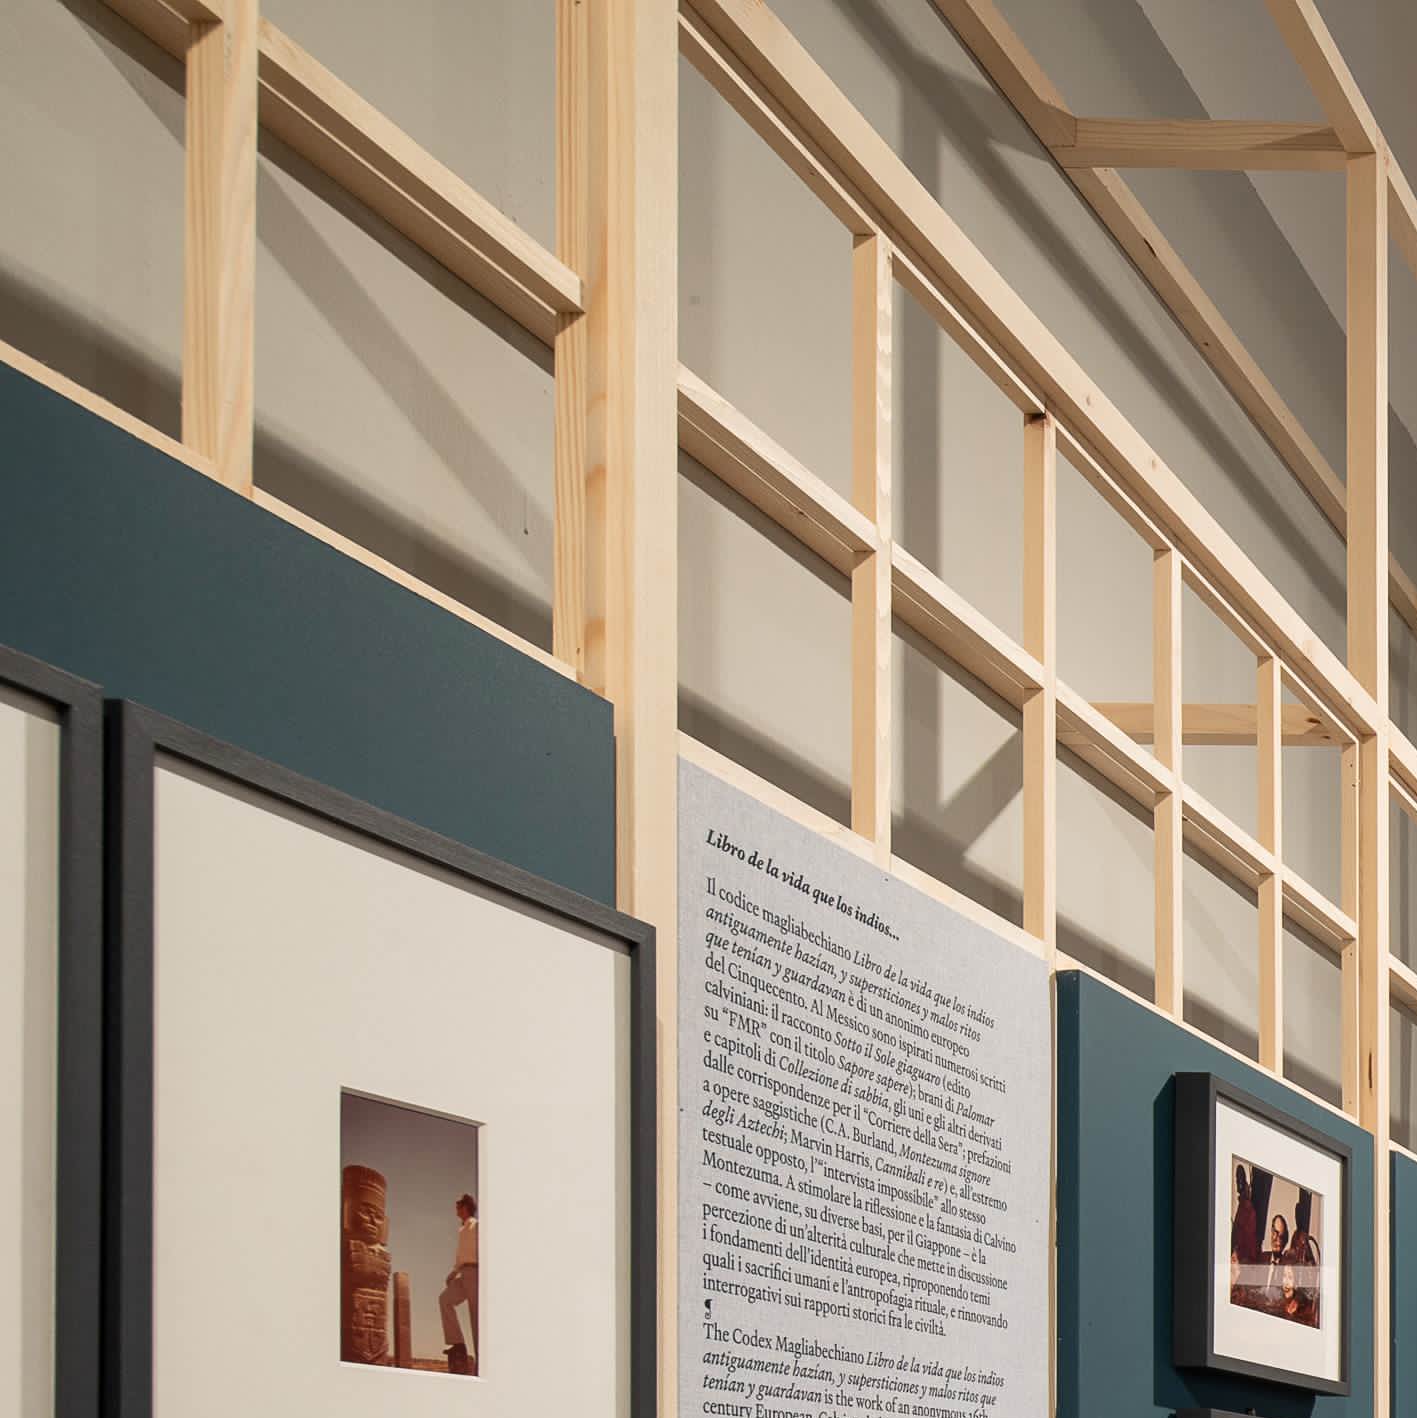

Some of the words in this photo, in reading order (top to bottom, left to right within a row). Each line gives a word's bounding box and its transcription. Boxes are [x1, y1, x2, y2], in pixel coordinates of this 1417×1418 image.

[706, 829, 746, 861] Libro
[747, 850, 764, 870] de
[766, 858, 779, 879] la
[782, 871, 810, 895] vida
[812, 888, 835, 907] que
[836, 895, 853, 917] los
[706, 908, 793, 956] antiguamente
[838, 970, 848, 985] y
[849, 974, 920, 1015] supersticiones
[920, 1008, 929, 1021] y
[930, 1011, 958, 1032] malos
[959, 1023, 981, 1042] ritos
[706, 932, 730, 951] que
[731, 941, 772, 970] tenían
[771, 962, 782, 978] y
[782, 967, 846, 1003] guardavan
[848, 990, 854, 1007] è
[856, 995, 867, 1013] di
[869, 1004, 883, 1020] un
[885, 1012, 929, 1040] anonimo
[931, 1033, 970, 1058] europeo
[707, 877, 716, 896] Il
[719, 888, 760, 917] codice
[762, 909, 851, 961] magliabechiano
[853, 950, 882, 975] Libro
[883, 964, 896, 982] de
[898, 969, 908, 988] la
[910, 979, 932, 999] vida
[933, 993, 951, 1008] que
[952, 996, 966, 1015] los
[967, 1004, 995, 1029] indios
[705, 952, 725, 975] del
[728, 962, 808, 1010] Cinquecento.
[810, 999, 823, 1016] Al
[826, 1004, 870, 1036] Messico
[872, 1028, 896, 1047] sono
[899, 1035, 933, 1063] ispirati
[935, 1055, 978, 1082] numerosi
[980, 1074, 1006, 1094] scritti
